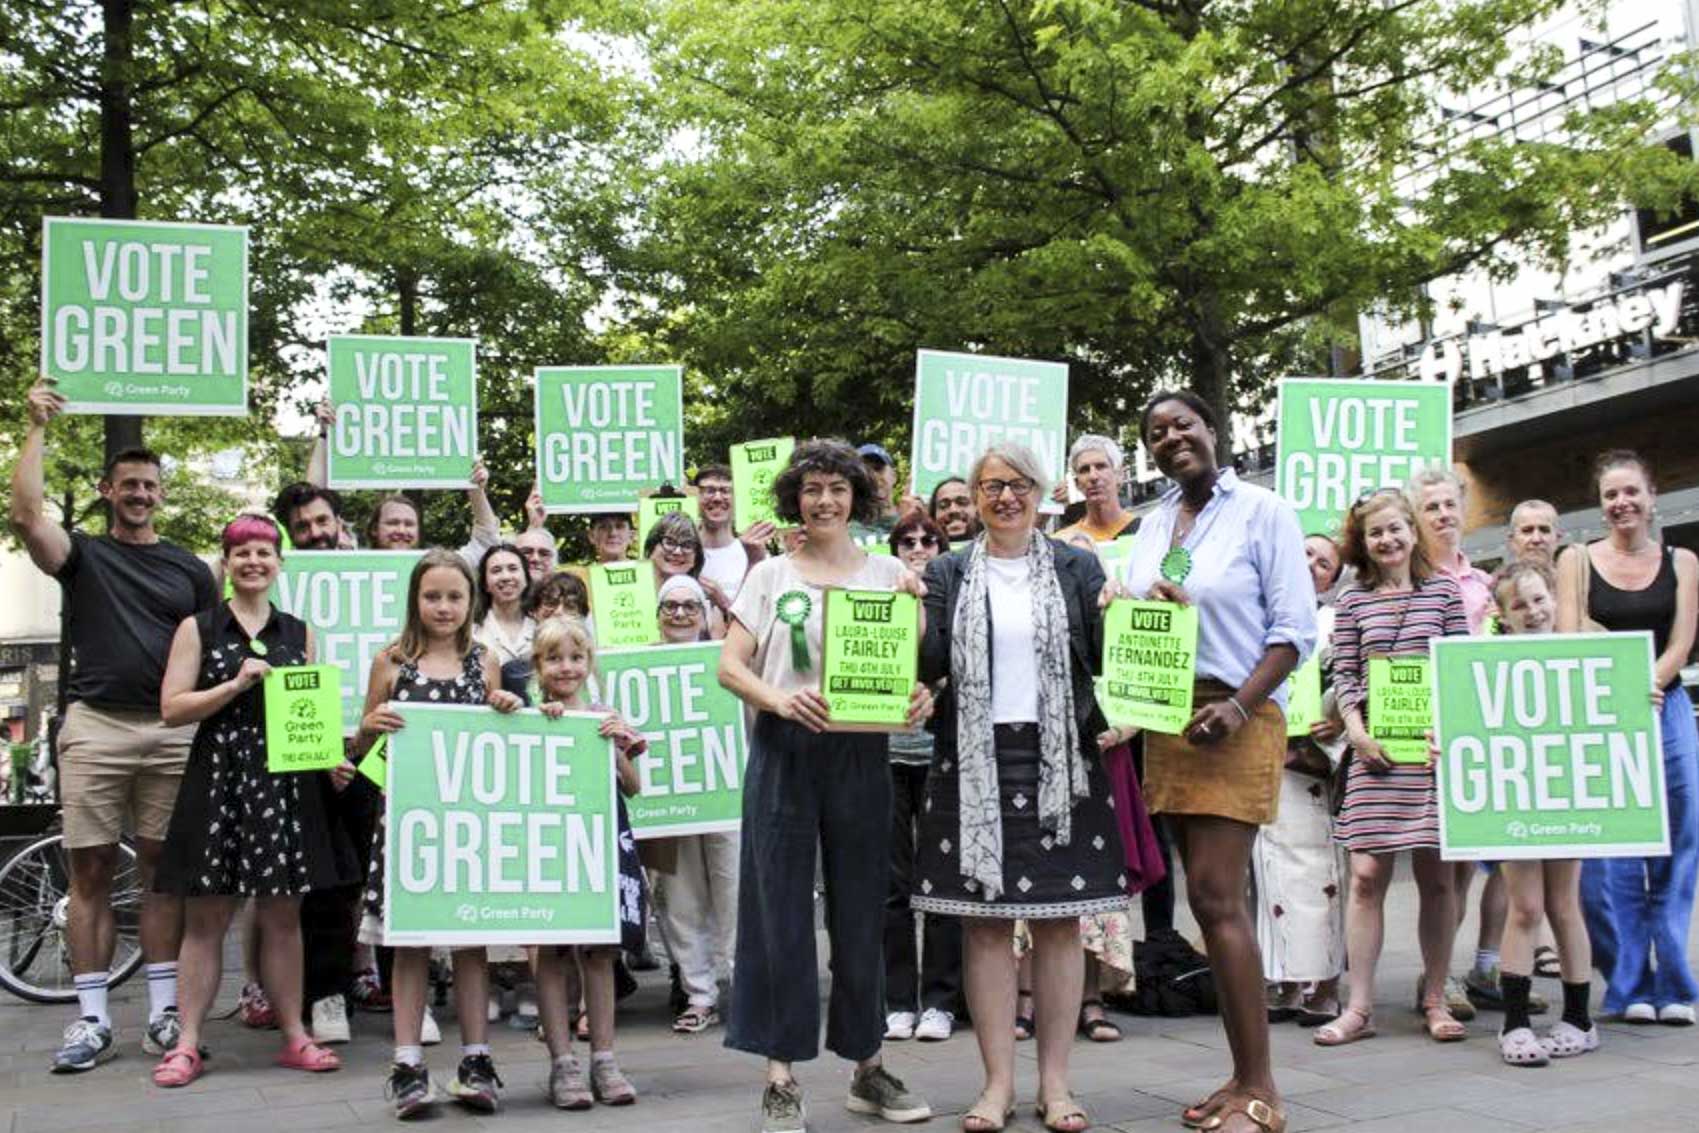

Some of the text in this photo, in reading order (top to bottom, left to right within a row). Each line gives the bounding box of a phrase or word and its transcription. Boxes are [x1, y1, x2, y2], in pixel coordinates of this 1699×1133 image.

[82, 240, 212, 304] VOTE
[54, 304, 237, 375] GREEN
[354, 351, 449, 401] VOTE
[126, 383, 190, 398] Green Party
[945, 369, 1040, 423] VOTE
[561, 381, 657, 427] VOTE
[335, 403, 469, 457] GREEN
[1308, 396, 1419, 451] VOTE
[545, 431, 676, 483] GREEN
[1284, 452, 1441, 511] GREE
[609, 569, 636, 585] VOTE
[277, 571, 399, 627] VOTE
[855, 601, 891, 621] VOTE
[835, 625, 908, 640] LAURA-LOUISE
[1133, 610, 1170, 631] VOTE
[843, 639, 899, 658] FAIRLEY
[1118, 633, 1182, 650] ANTOINETTE
[1108, 645, 1191, 669] FERNANDEZ
[285, 672, 319, 689] VOTE
[1391, 666, 1421, 683] VOTE
[1383, 697, 1429, 712] FAIRLEY
[1471, 657, 1617, 729] VOTE
[285, 720, 325, 733] Green
[288, 733, 323, 745] Party
[431, 730, 576, 806] VOTE
[640, 725, 739, 797] EEN
[1449, 731, 1654, 813] GREEN
[636, 803, 698, 819] Green Party
[1530, 822, 1602, 837] Green Party
[399, 808, 606, 894] GREEN
[480, 906, 555, 922] Green Party
